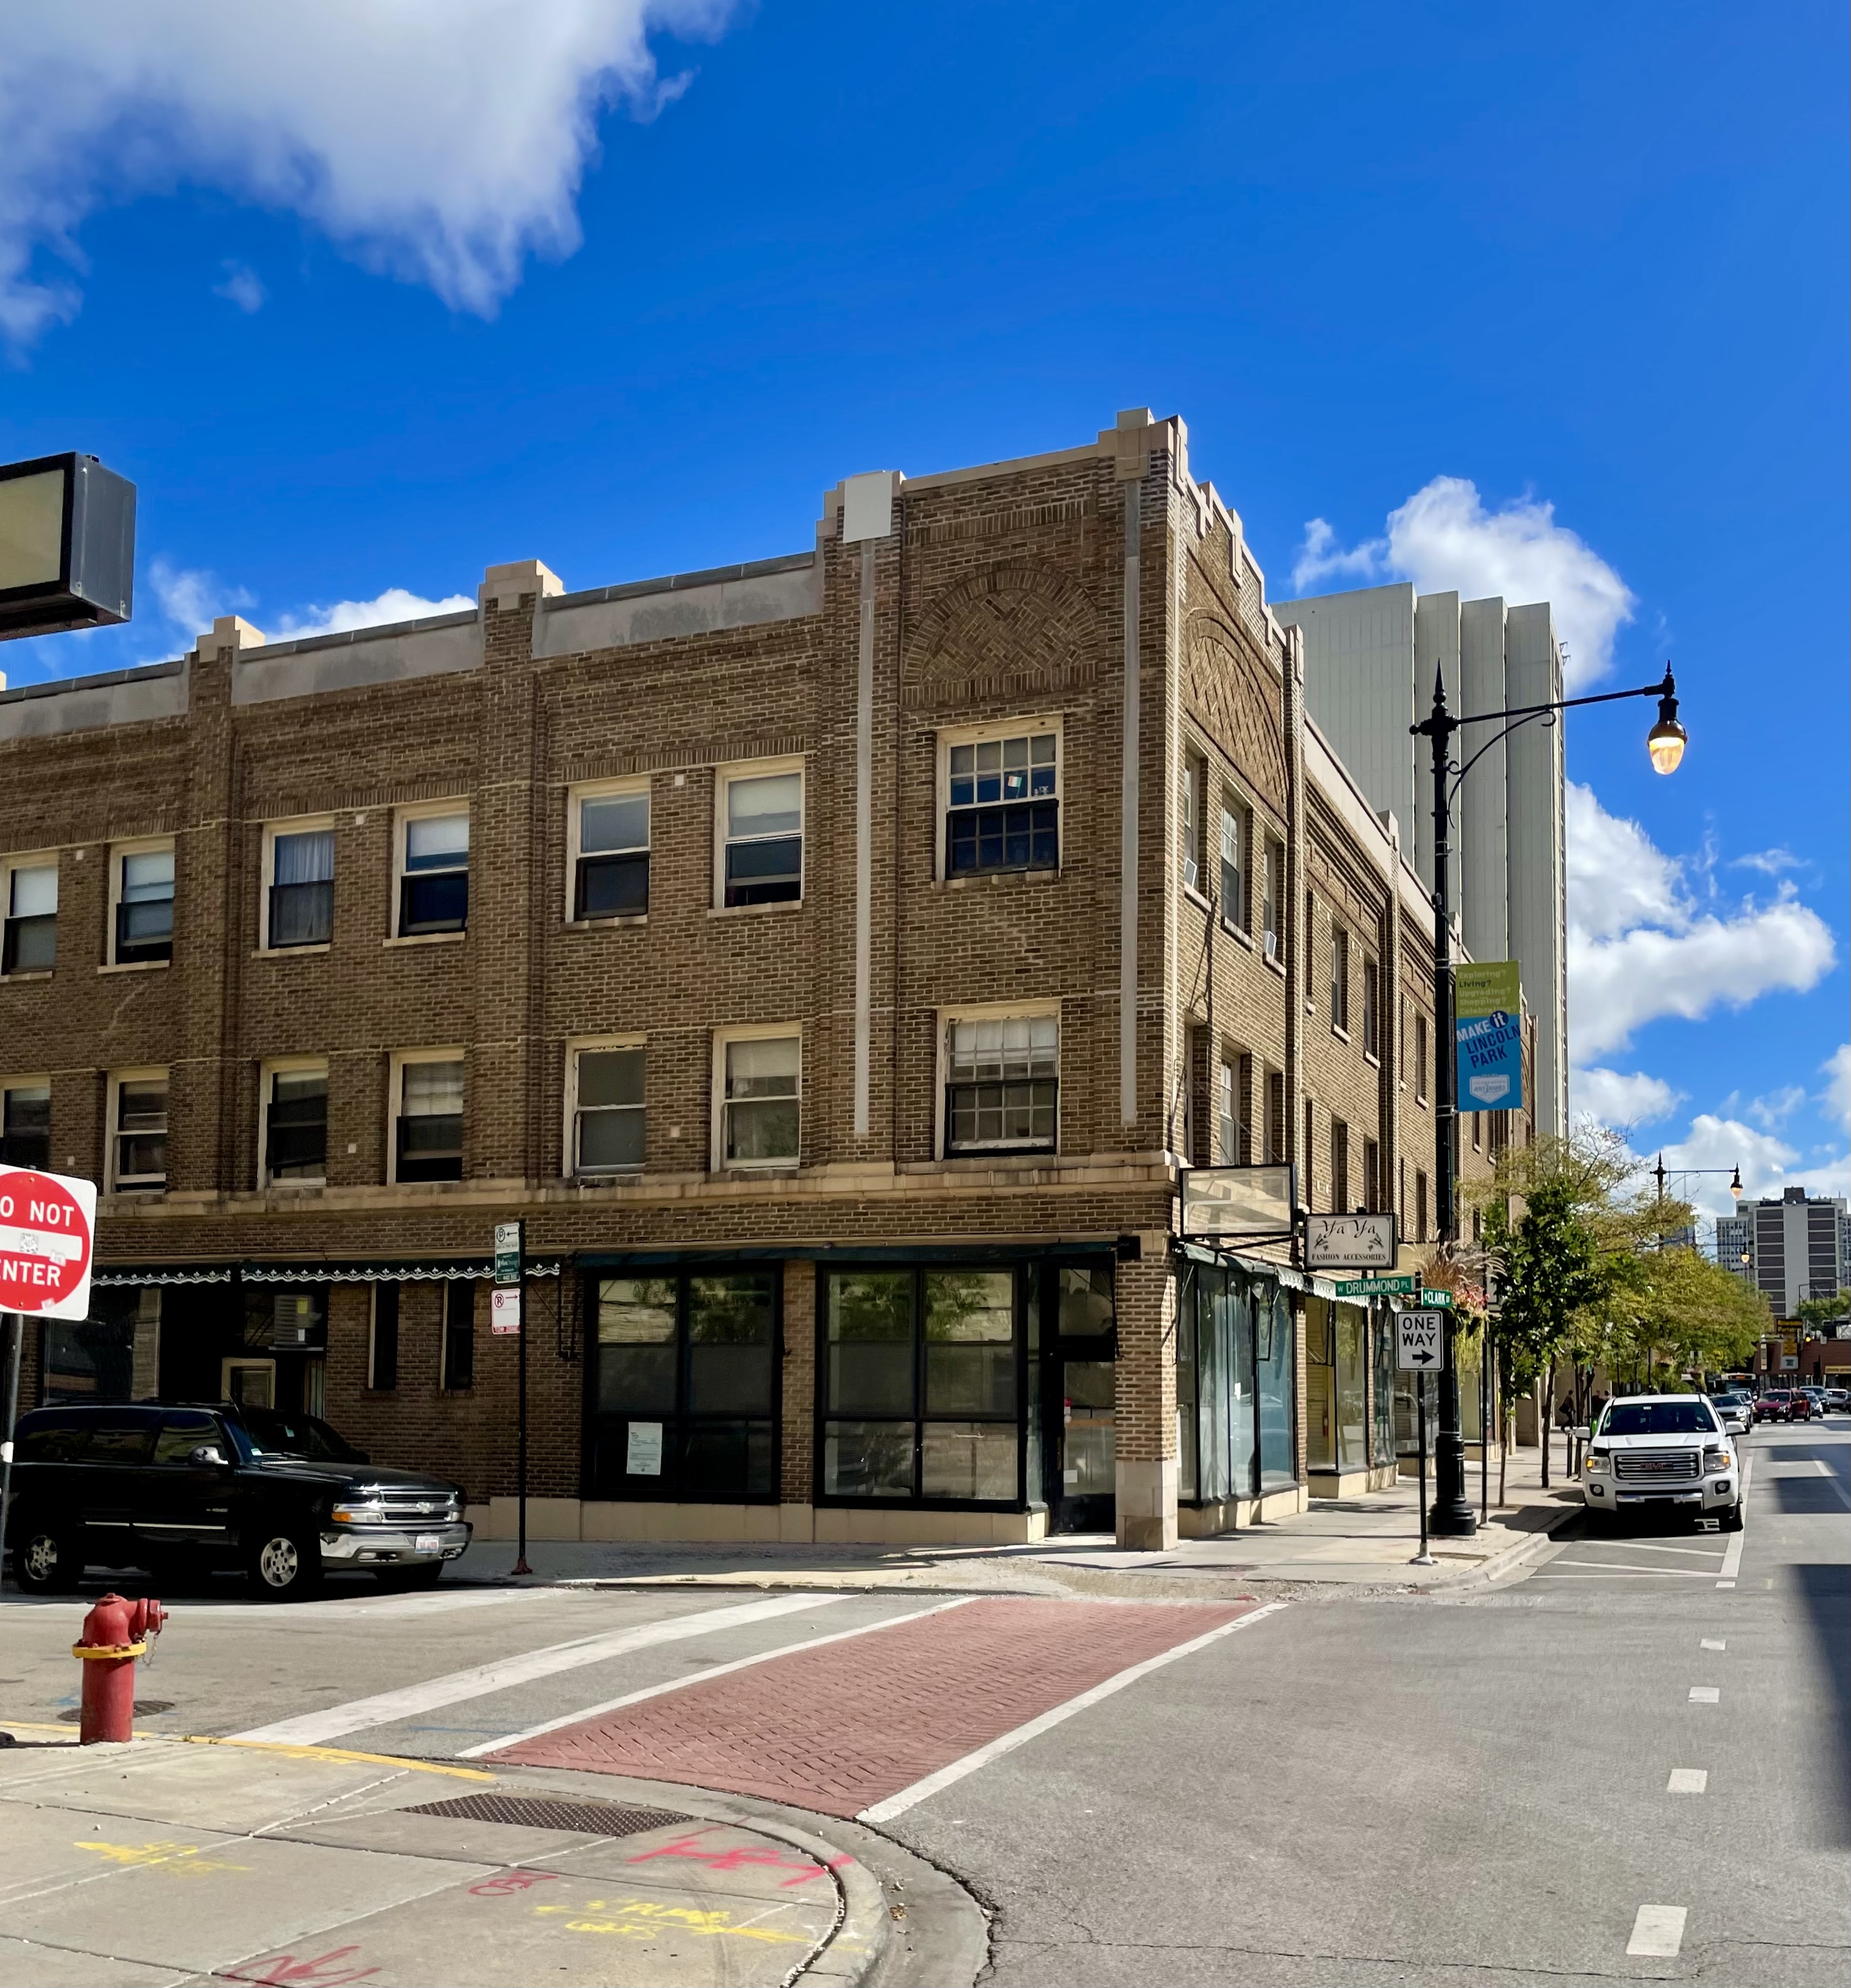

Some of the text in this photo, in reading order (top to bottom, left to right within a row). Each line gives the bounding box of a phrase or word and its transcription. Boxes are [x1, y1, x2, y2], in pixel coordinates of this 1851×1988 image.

[1459, 980, 1491, 988] Living?
[1456, 1012, 1506, 1042] MAKE it
[1466, 1024, 1520, 1055] LINCOLN
[1471, 1045, 1508, 1068] PARK
[0, 1195, 74, 1226] O NOT
[1321, 1220, 1375, 1238] Ya Ya
[0, 1259, 61, 1287] NTER
[1346, 1279, 1400, 1294] DRUMMOND
[1428, 1291, 1446, 1305] CLARK
[1403, 1317, 1436, 1330] ONE
[1402, 1333, 1436, 1346] WAY
